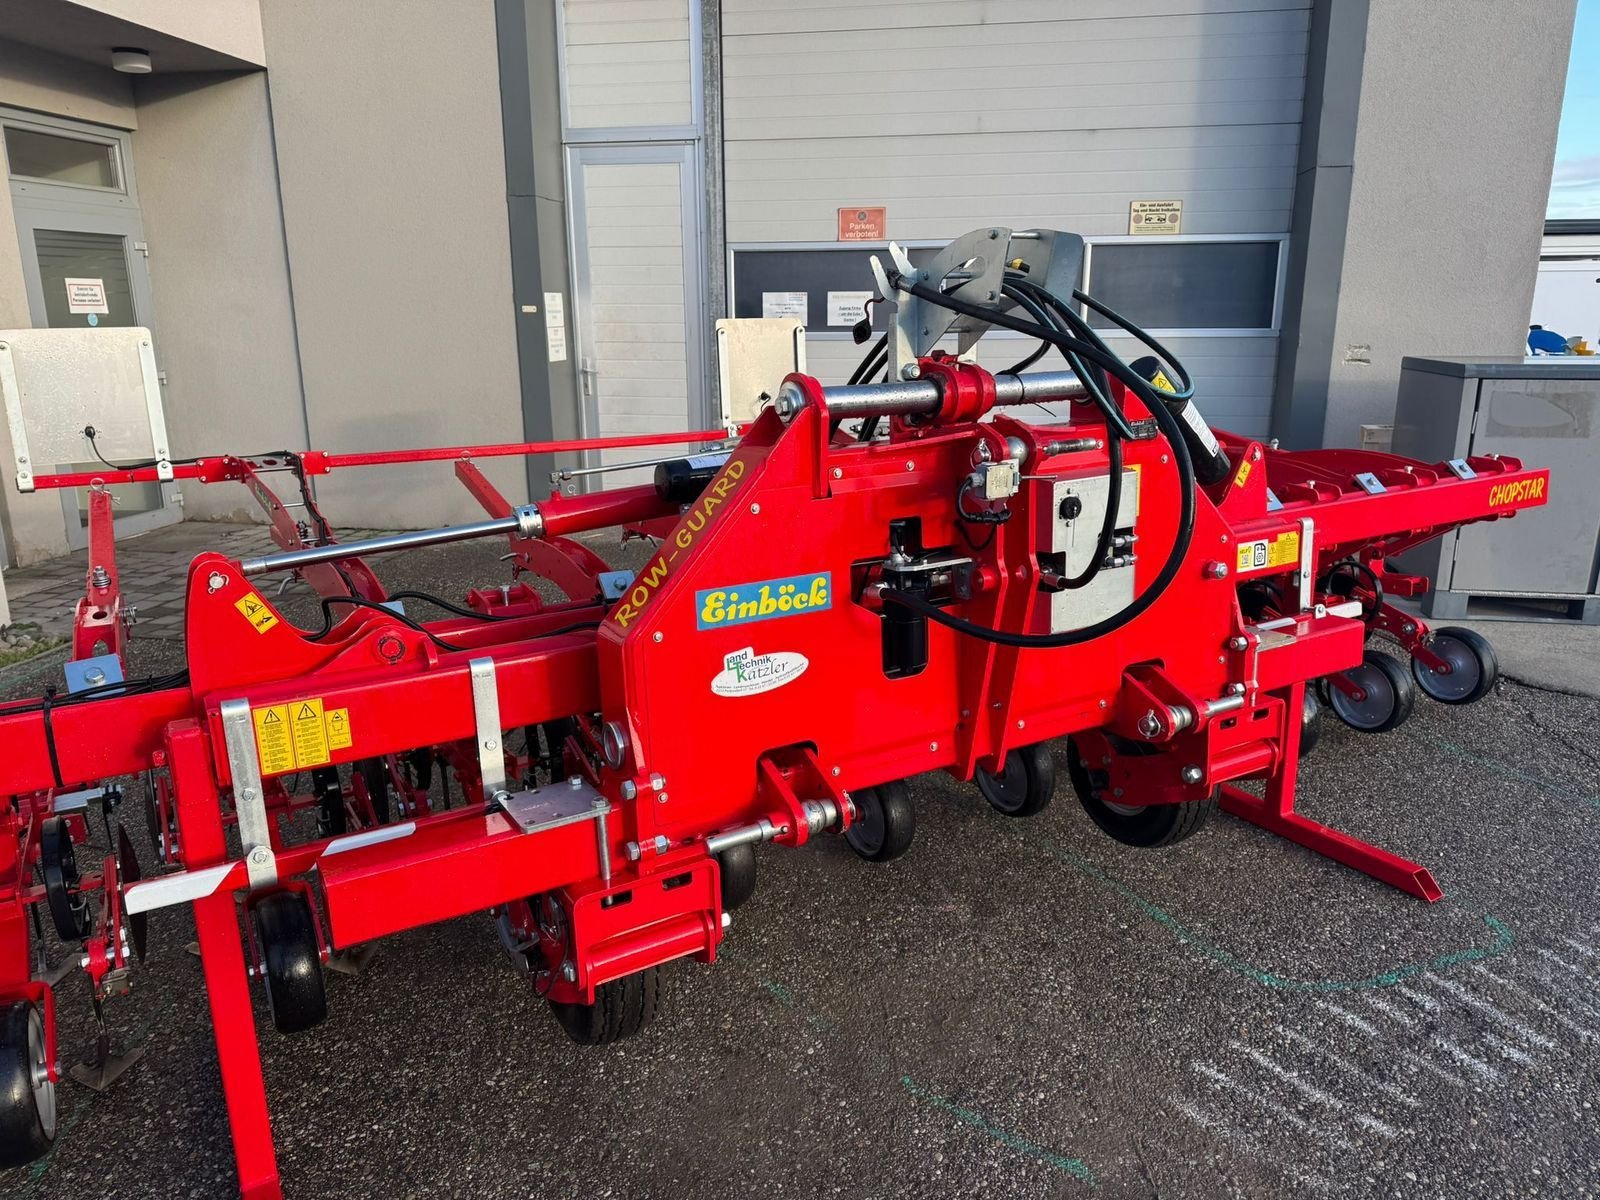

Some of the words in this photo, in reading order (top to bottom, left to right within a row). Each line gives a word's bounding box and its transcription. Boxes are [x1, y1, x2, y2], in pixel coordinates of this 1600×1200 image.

[845, 230, 879, 238] verboten!
[849, 222, 875, 230] Parken
[1489, 477, 1545, 507] CHOPSTAR
[614, 460, 745, 628] ROW-GUARD
[701, 577, 827, 623] Einböck
[726, 651, 747, 671] Land
[733, 655, 772, 671] Technik
